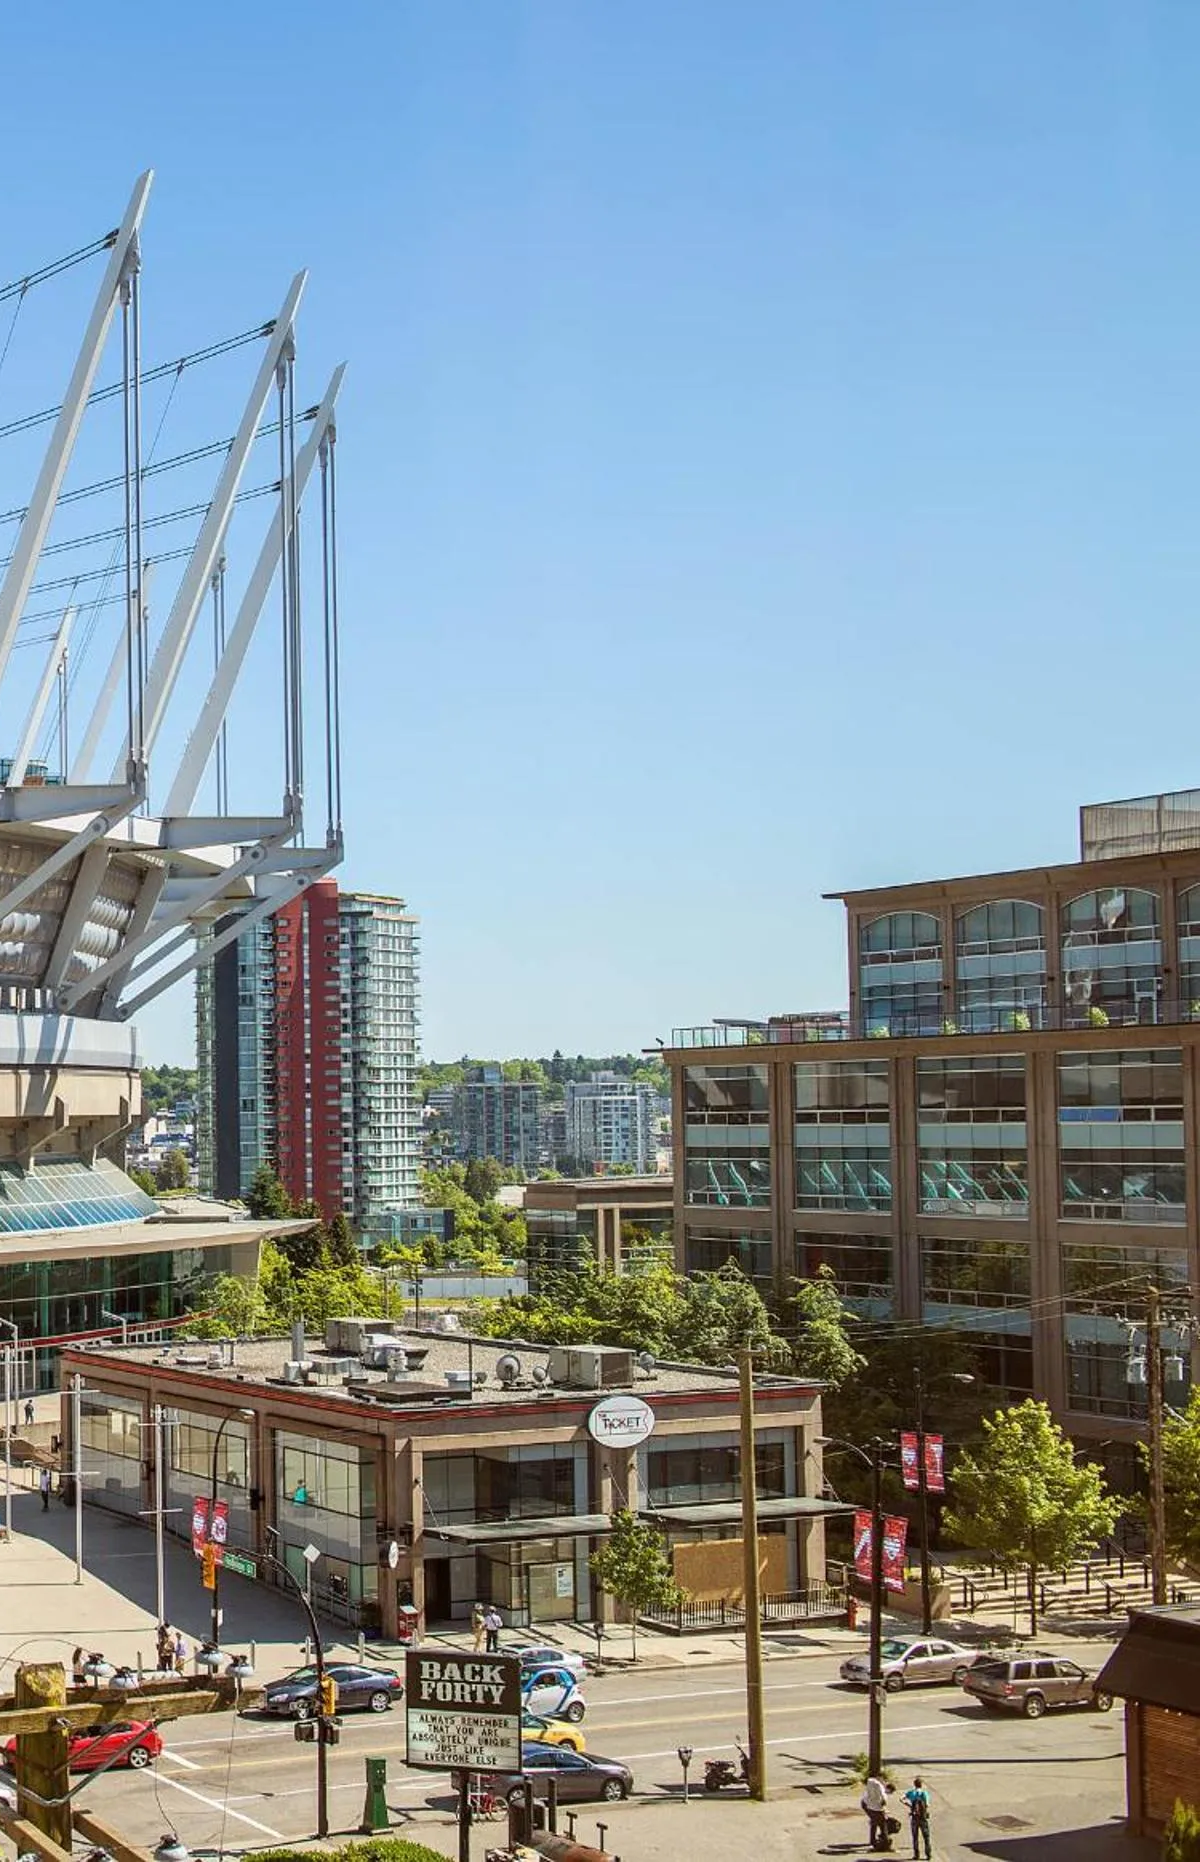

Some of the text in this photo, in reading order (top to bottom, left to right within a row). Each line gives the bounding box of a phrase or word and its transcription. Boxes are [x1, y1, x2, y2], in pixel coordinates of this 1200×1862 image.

[602, 1416, 641, 1435] TICKET
[419, 1661, 506, 1684] BACK
[420, 1680, 506, 1705] FORTY
[419, 1714, 509, 1728] ALWAYS REMEMBER
[428, 1724, 499, 1737] THAT YOU ARE
[412, 1733, 511, 1748] ABSOLUTELY UNIQUE
[435, 1744, 485, 1755] JUST LIKE
[424, 1752, 497, 1766] EVERYONE ELSE
